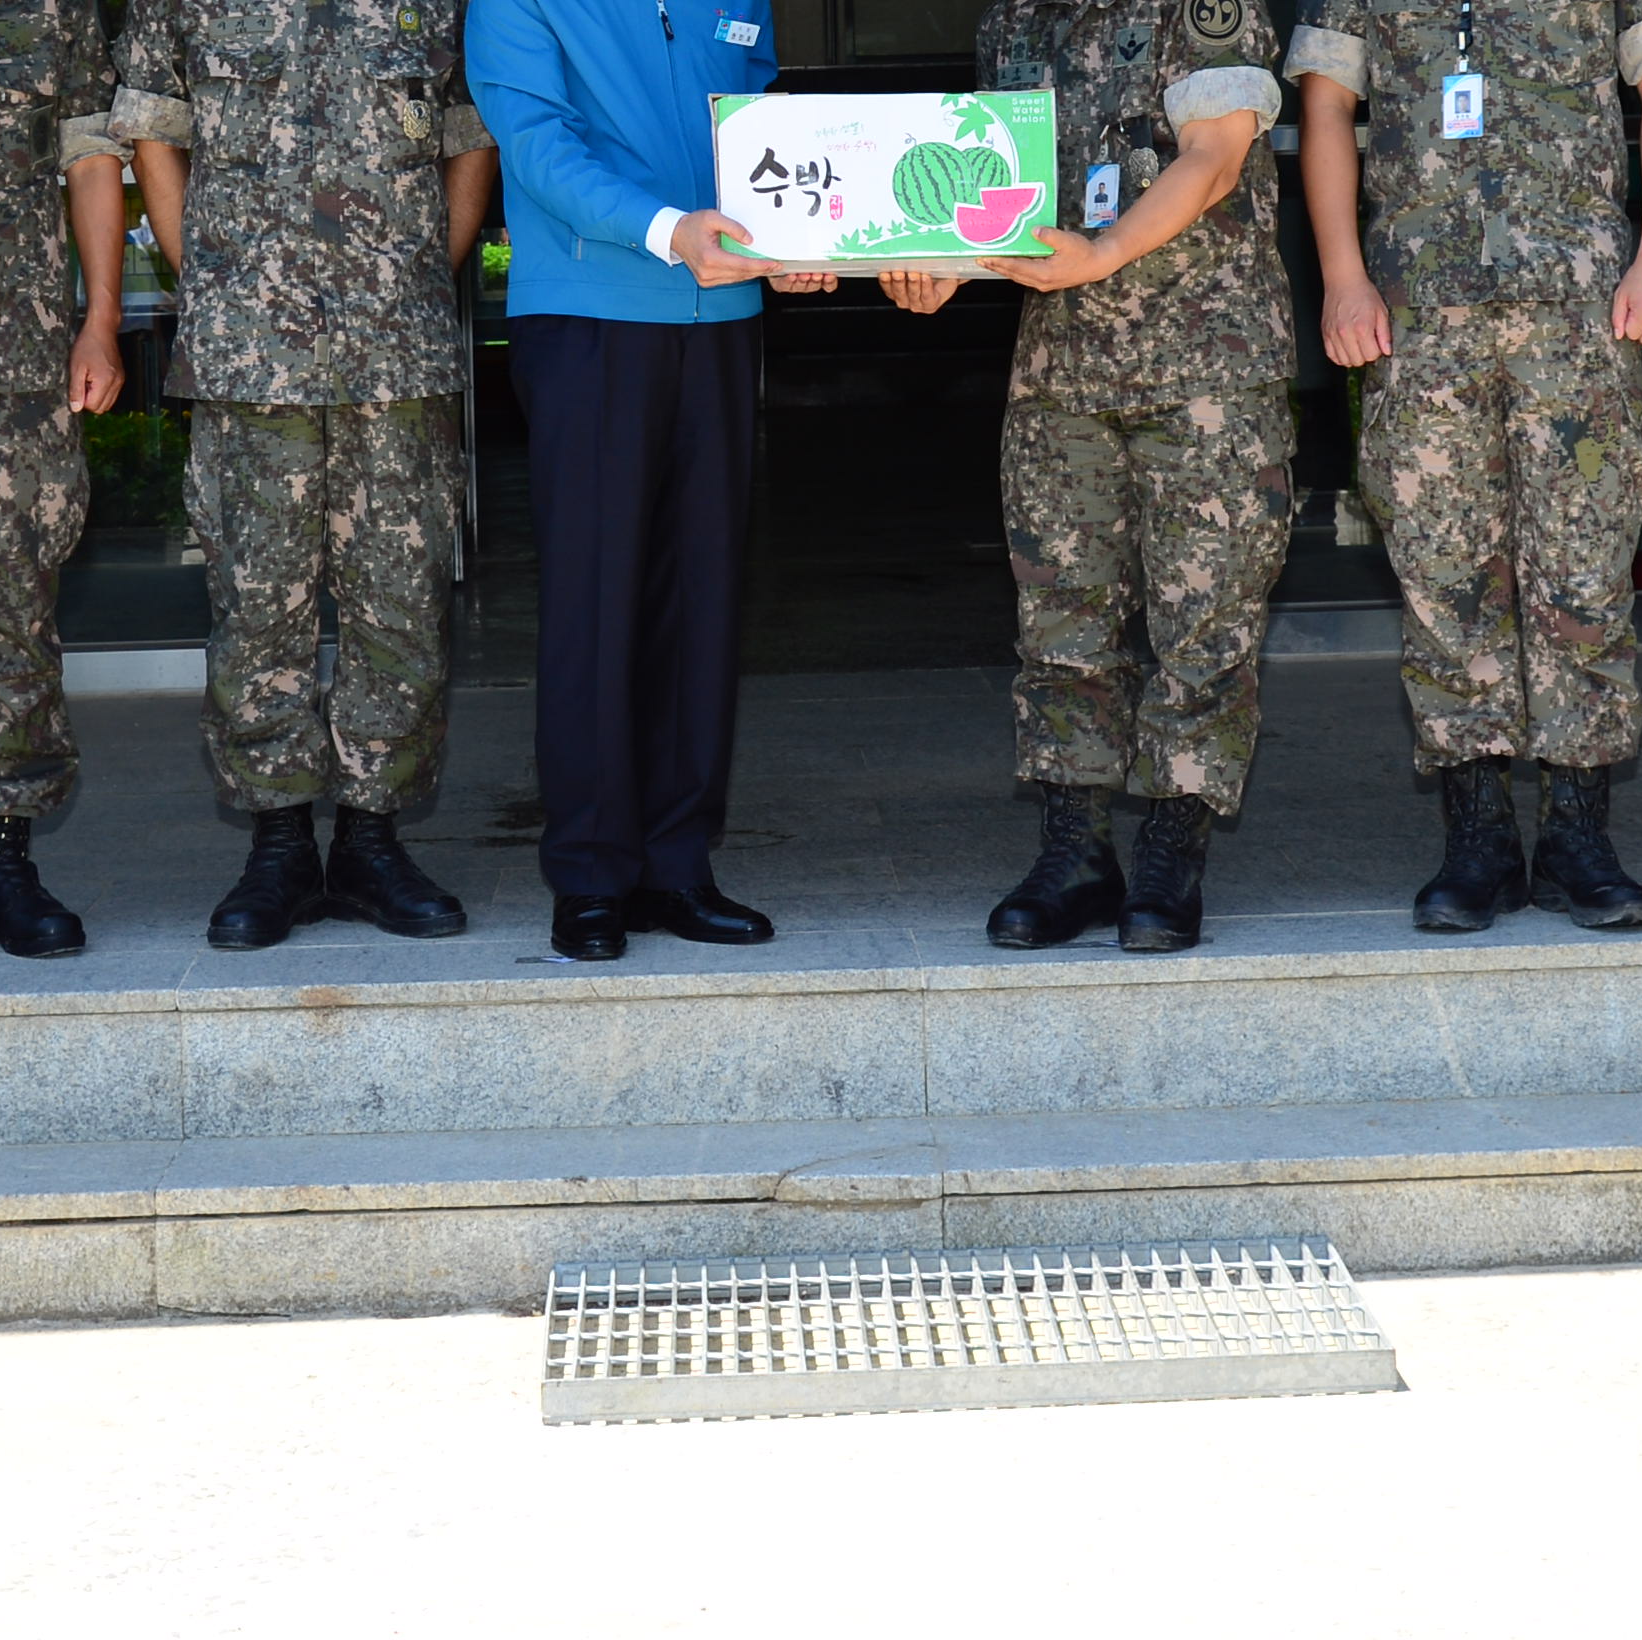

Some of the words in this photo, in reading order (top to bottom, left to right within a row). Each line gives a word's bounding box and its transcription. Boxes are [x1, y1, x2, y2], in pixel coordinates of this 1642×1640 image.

[1012, 97, 1045, 105] Sweet
[1012, 106, 1046, 114] Water
[1012, 115, 1046, 123] Melon
[749, 147, 842, 217] 수박
